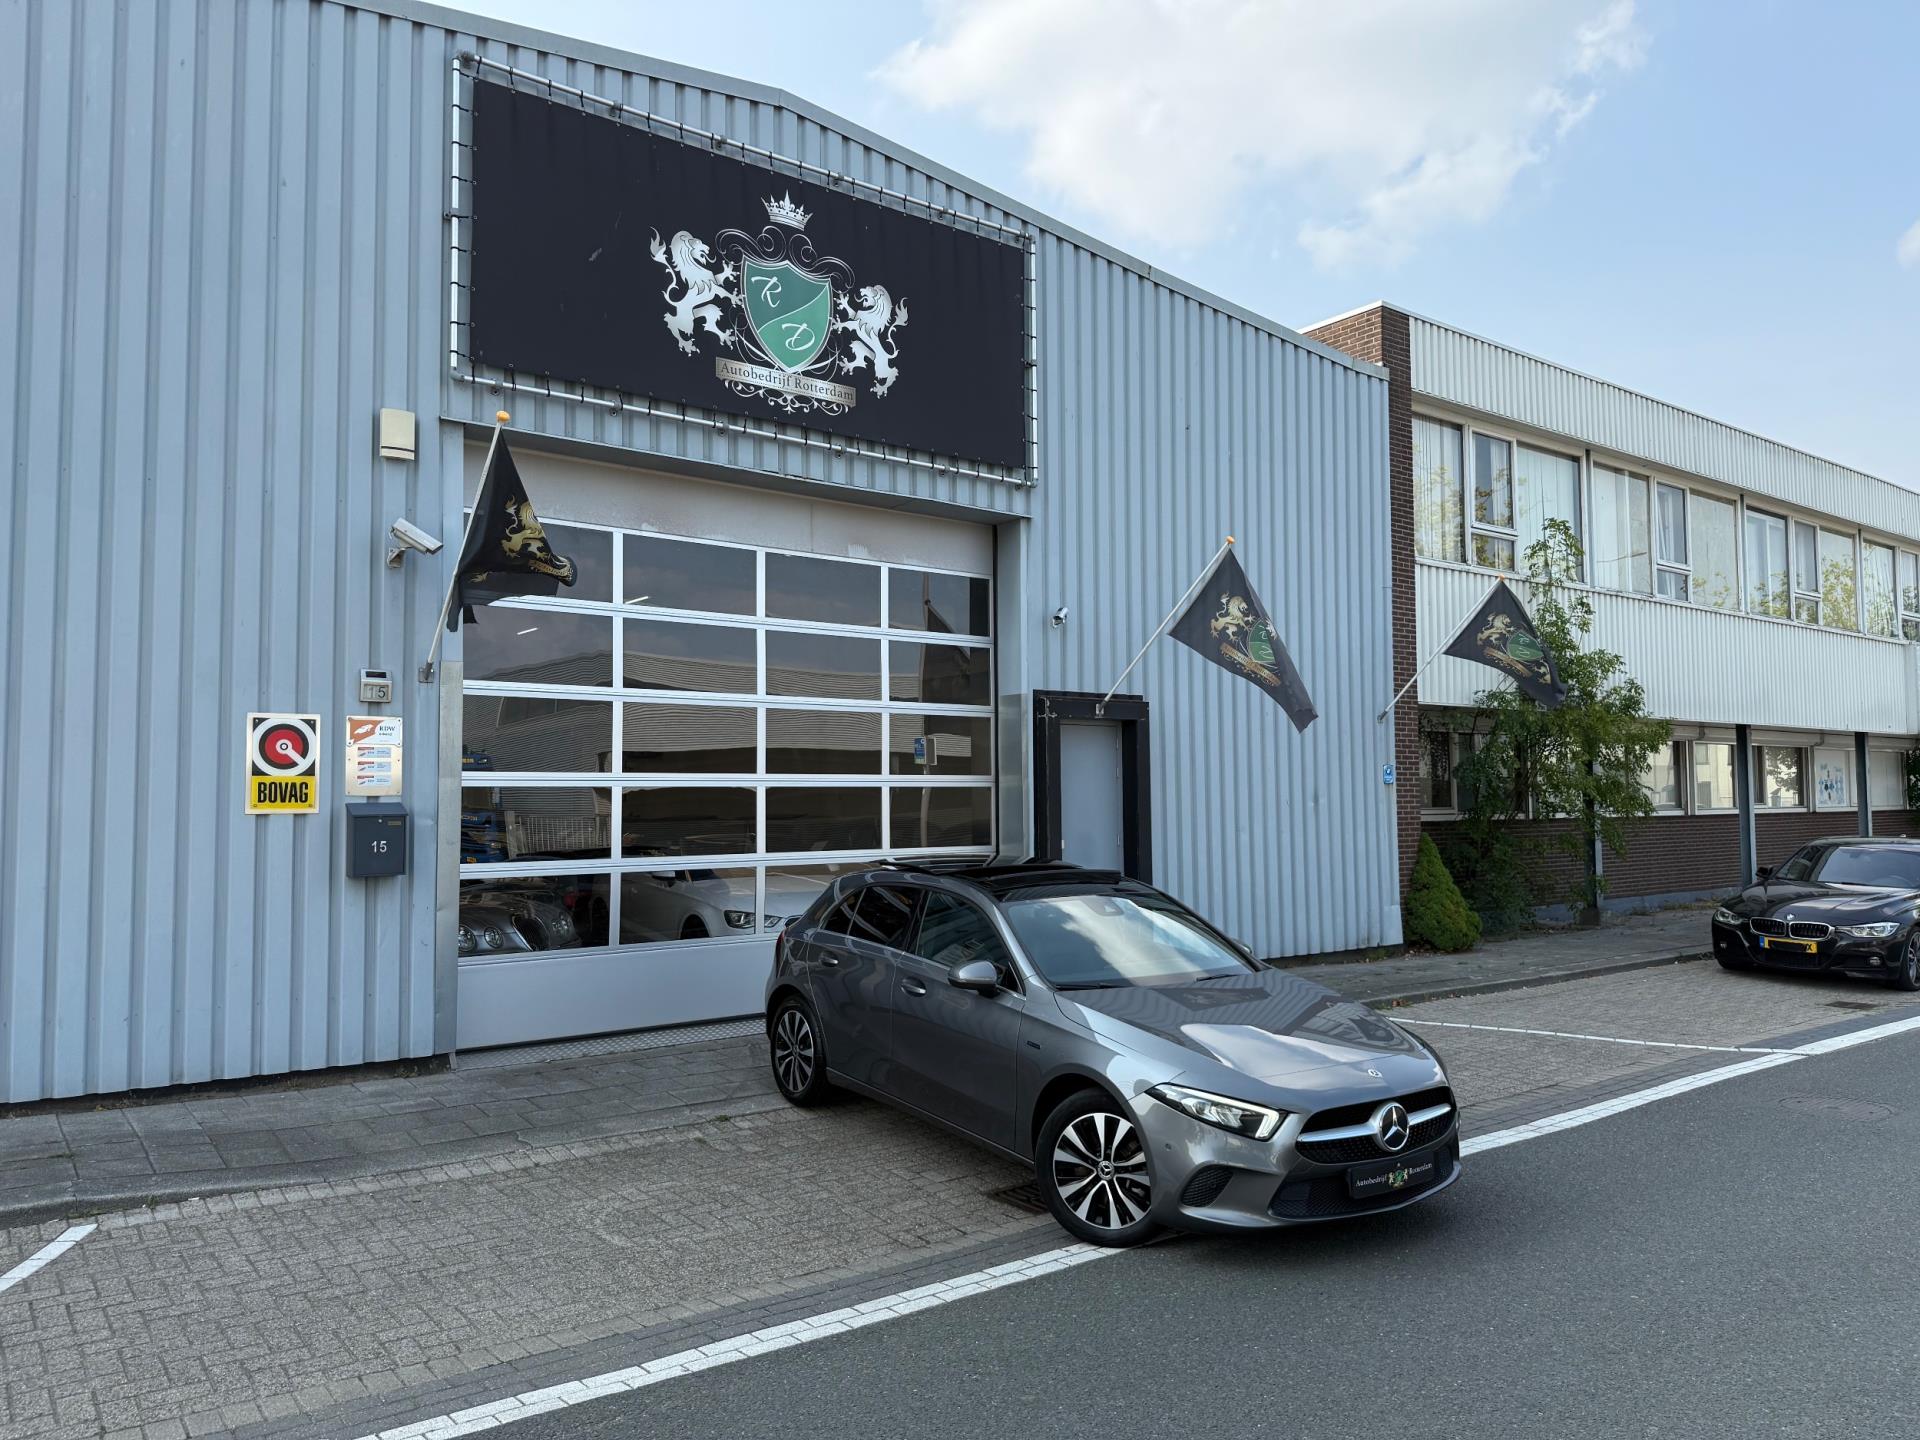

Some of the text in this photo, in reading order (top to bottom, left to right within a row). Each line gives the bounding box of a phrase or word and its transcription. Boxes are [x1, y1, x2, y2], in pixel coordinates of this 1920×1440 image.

[751, 276, 782, 308] R
[781, 323, 815, 351] D
[721, 361, 854, 401] Autobedrijf Rotterdam
[368, 685, 386, 699] 15
[257, 781, 309, 804] BOVAG
[371, 840, 387, 853] 15
